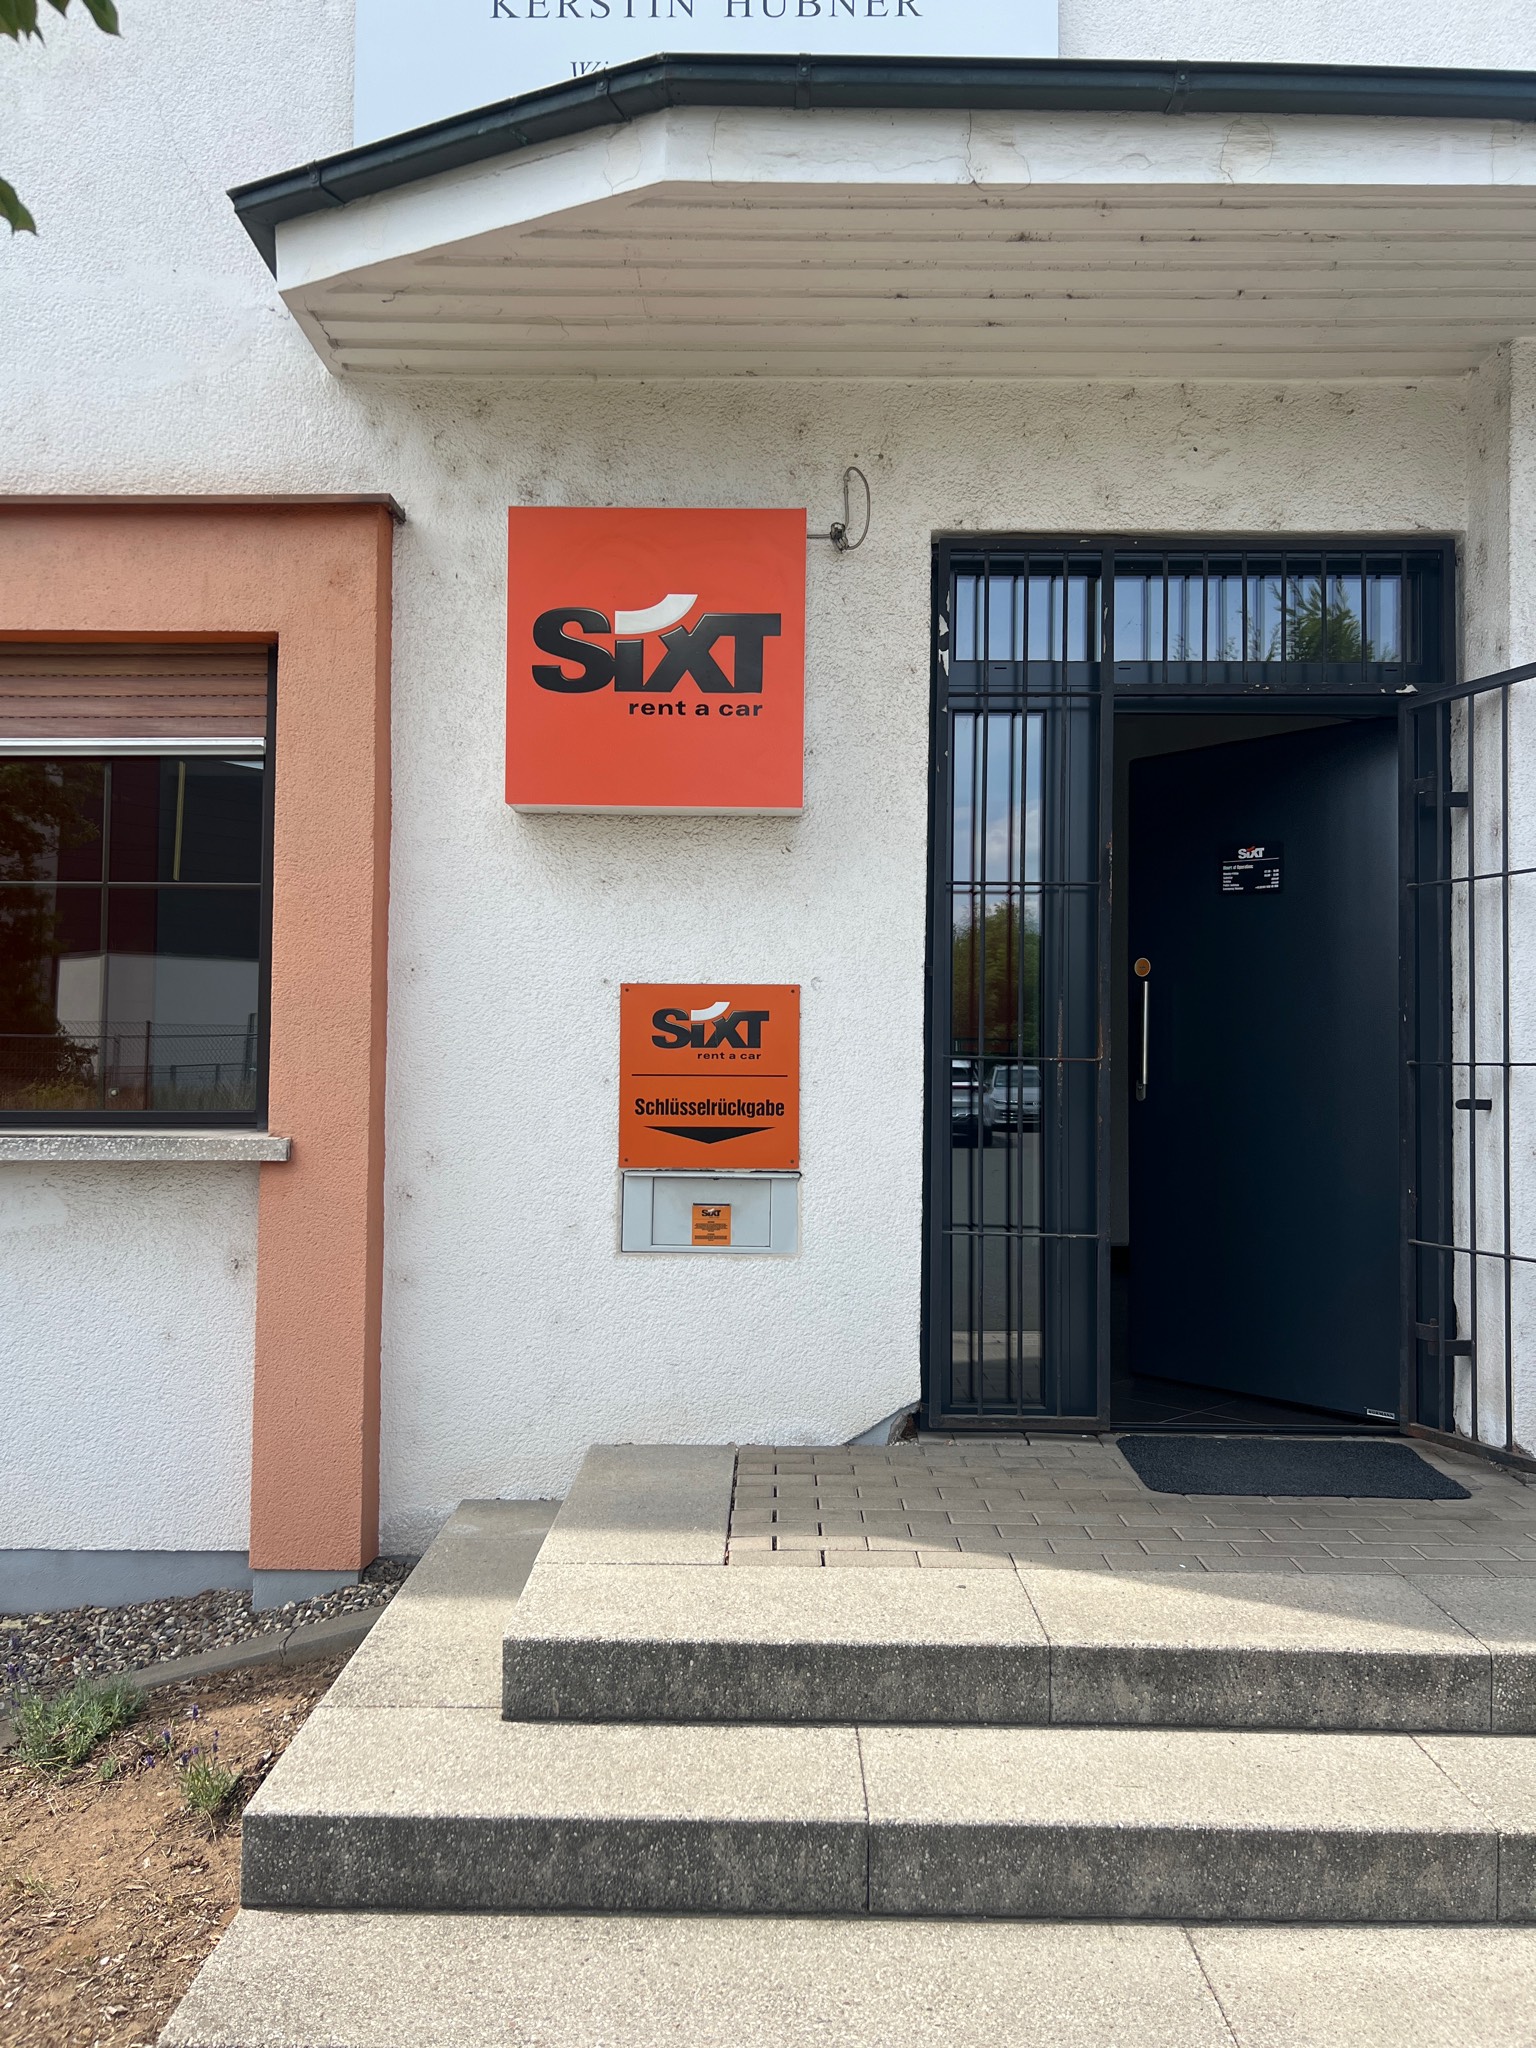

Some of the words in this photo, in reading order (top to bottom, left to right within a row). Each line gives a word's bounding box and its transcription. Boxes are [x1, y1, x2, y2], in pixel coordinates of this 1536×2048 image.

[628, 700, 687, 716] rent
[694, 703, 710, 717] a
[718, 703, 764, 717] car
[697, 1052, 725, 1060] rent
[634, 1097, 785, 1118] Schlüsselrückgabe
